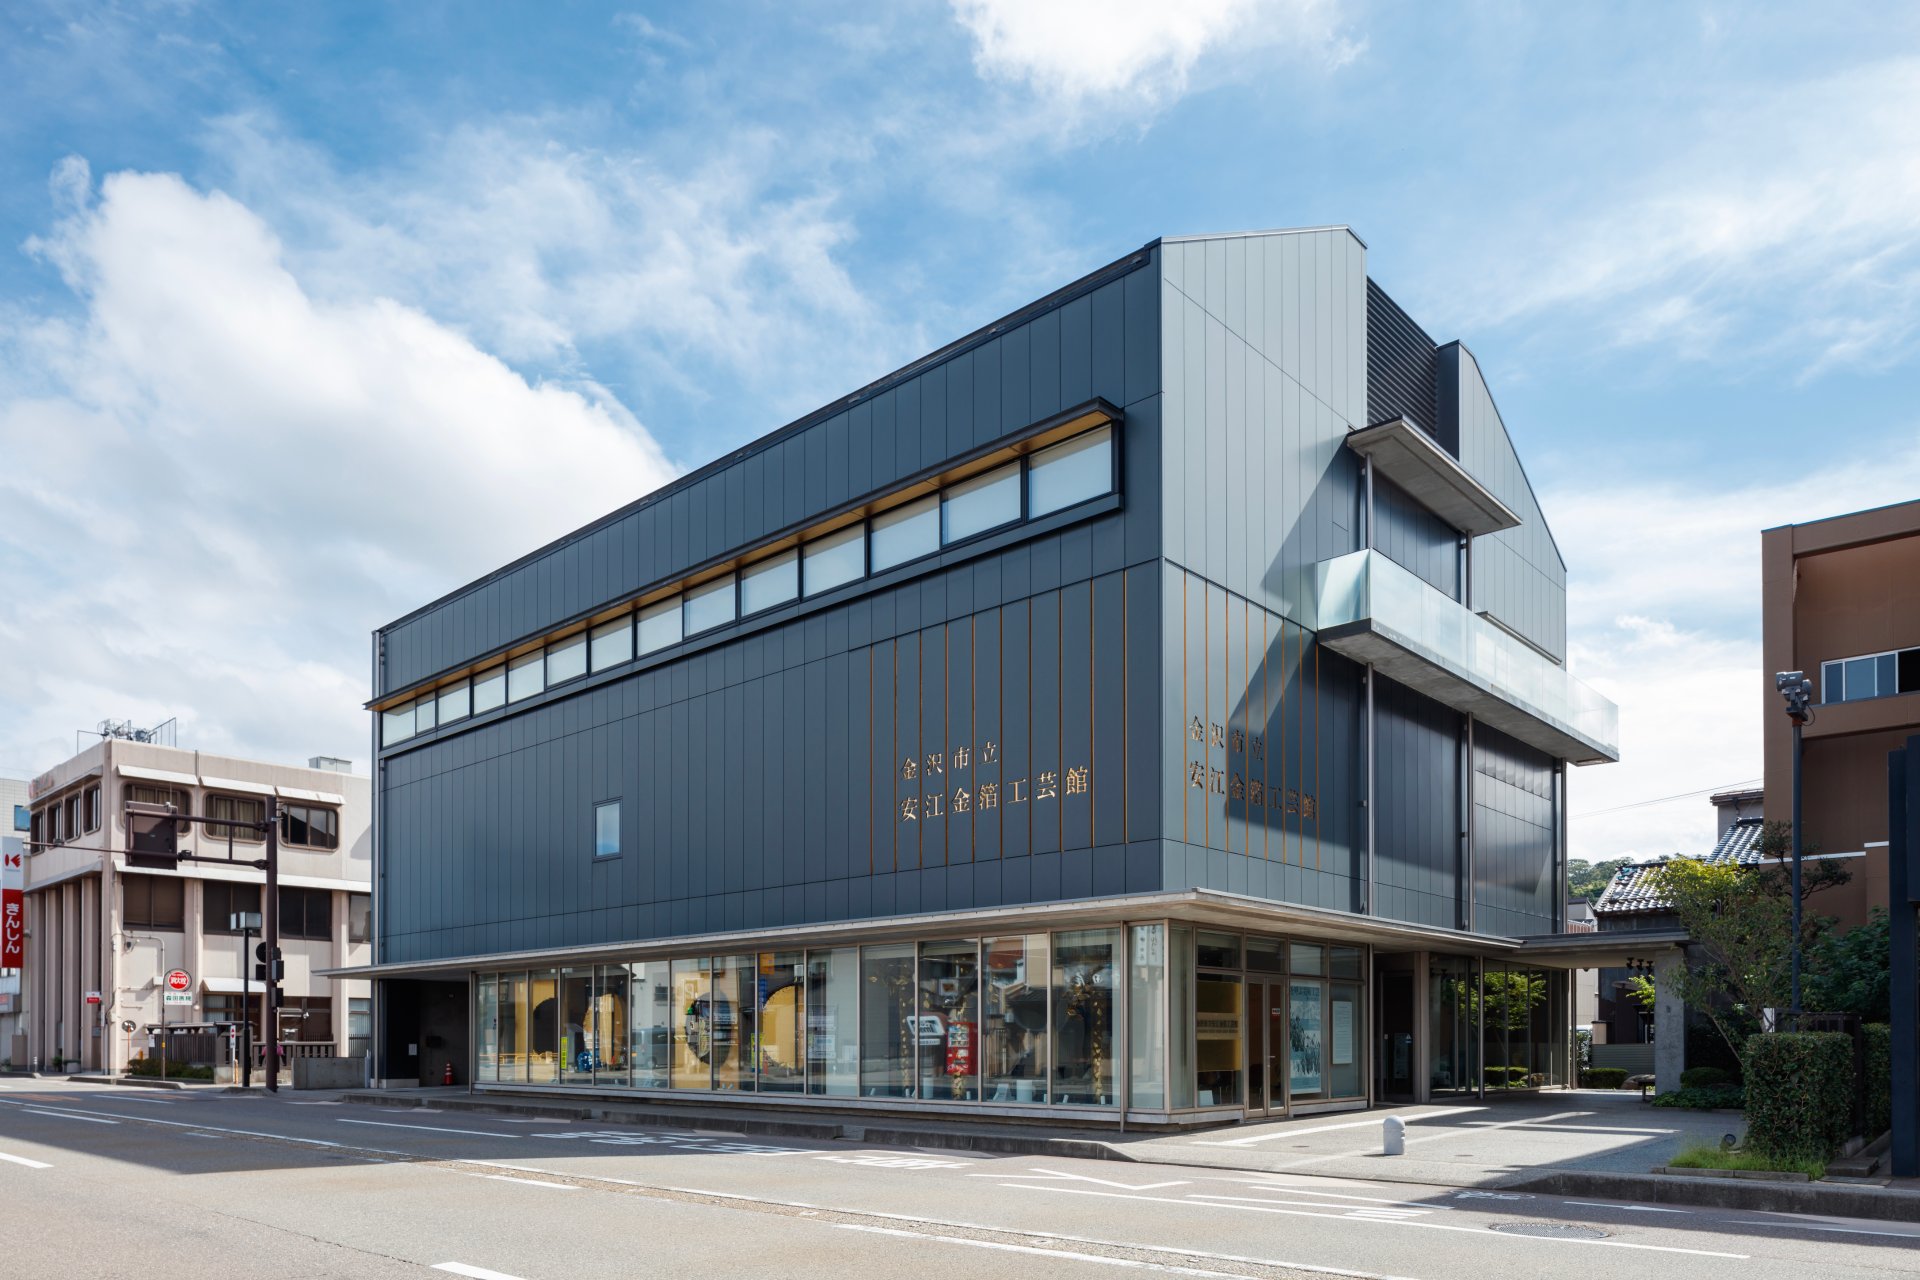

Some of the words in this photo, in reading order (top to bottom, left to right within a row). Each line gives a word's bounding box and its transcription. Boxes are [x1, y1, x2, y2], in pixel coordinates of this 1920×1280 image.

[902, 741, 998, 781] 金沢市立
[1189, 715, 1263, 761] 金沢市立
[901, 765, 1088, 822] 安江金箔工芸館
[5, 902, 20, 954] きんしん
